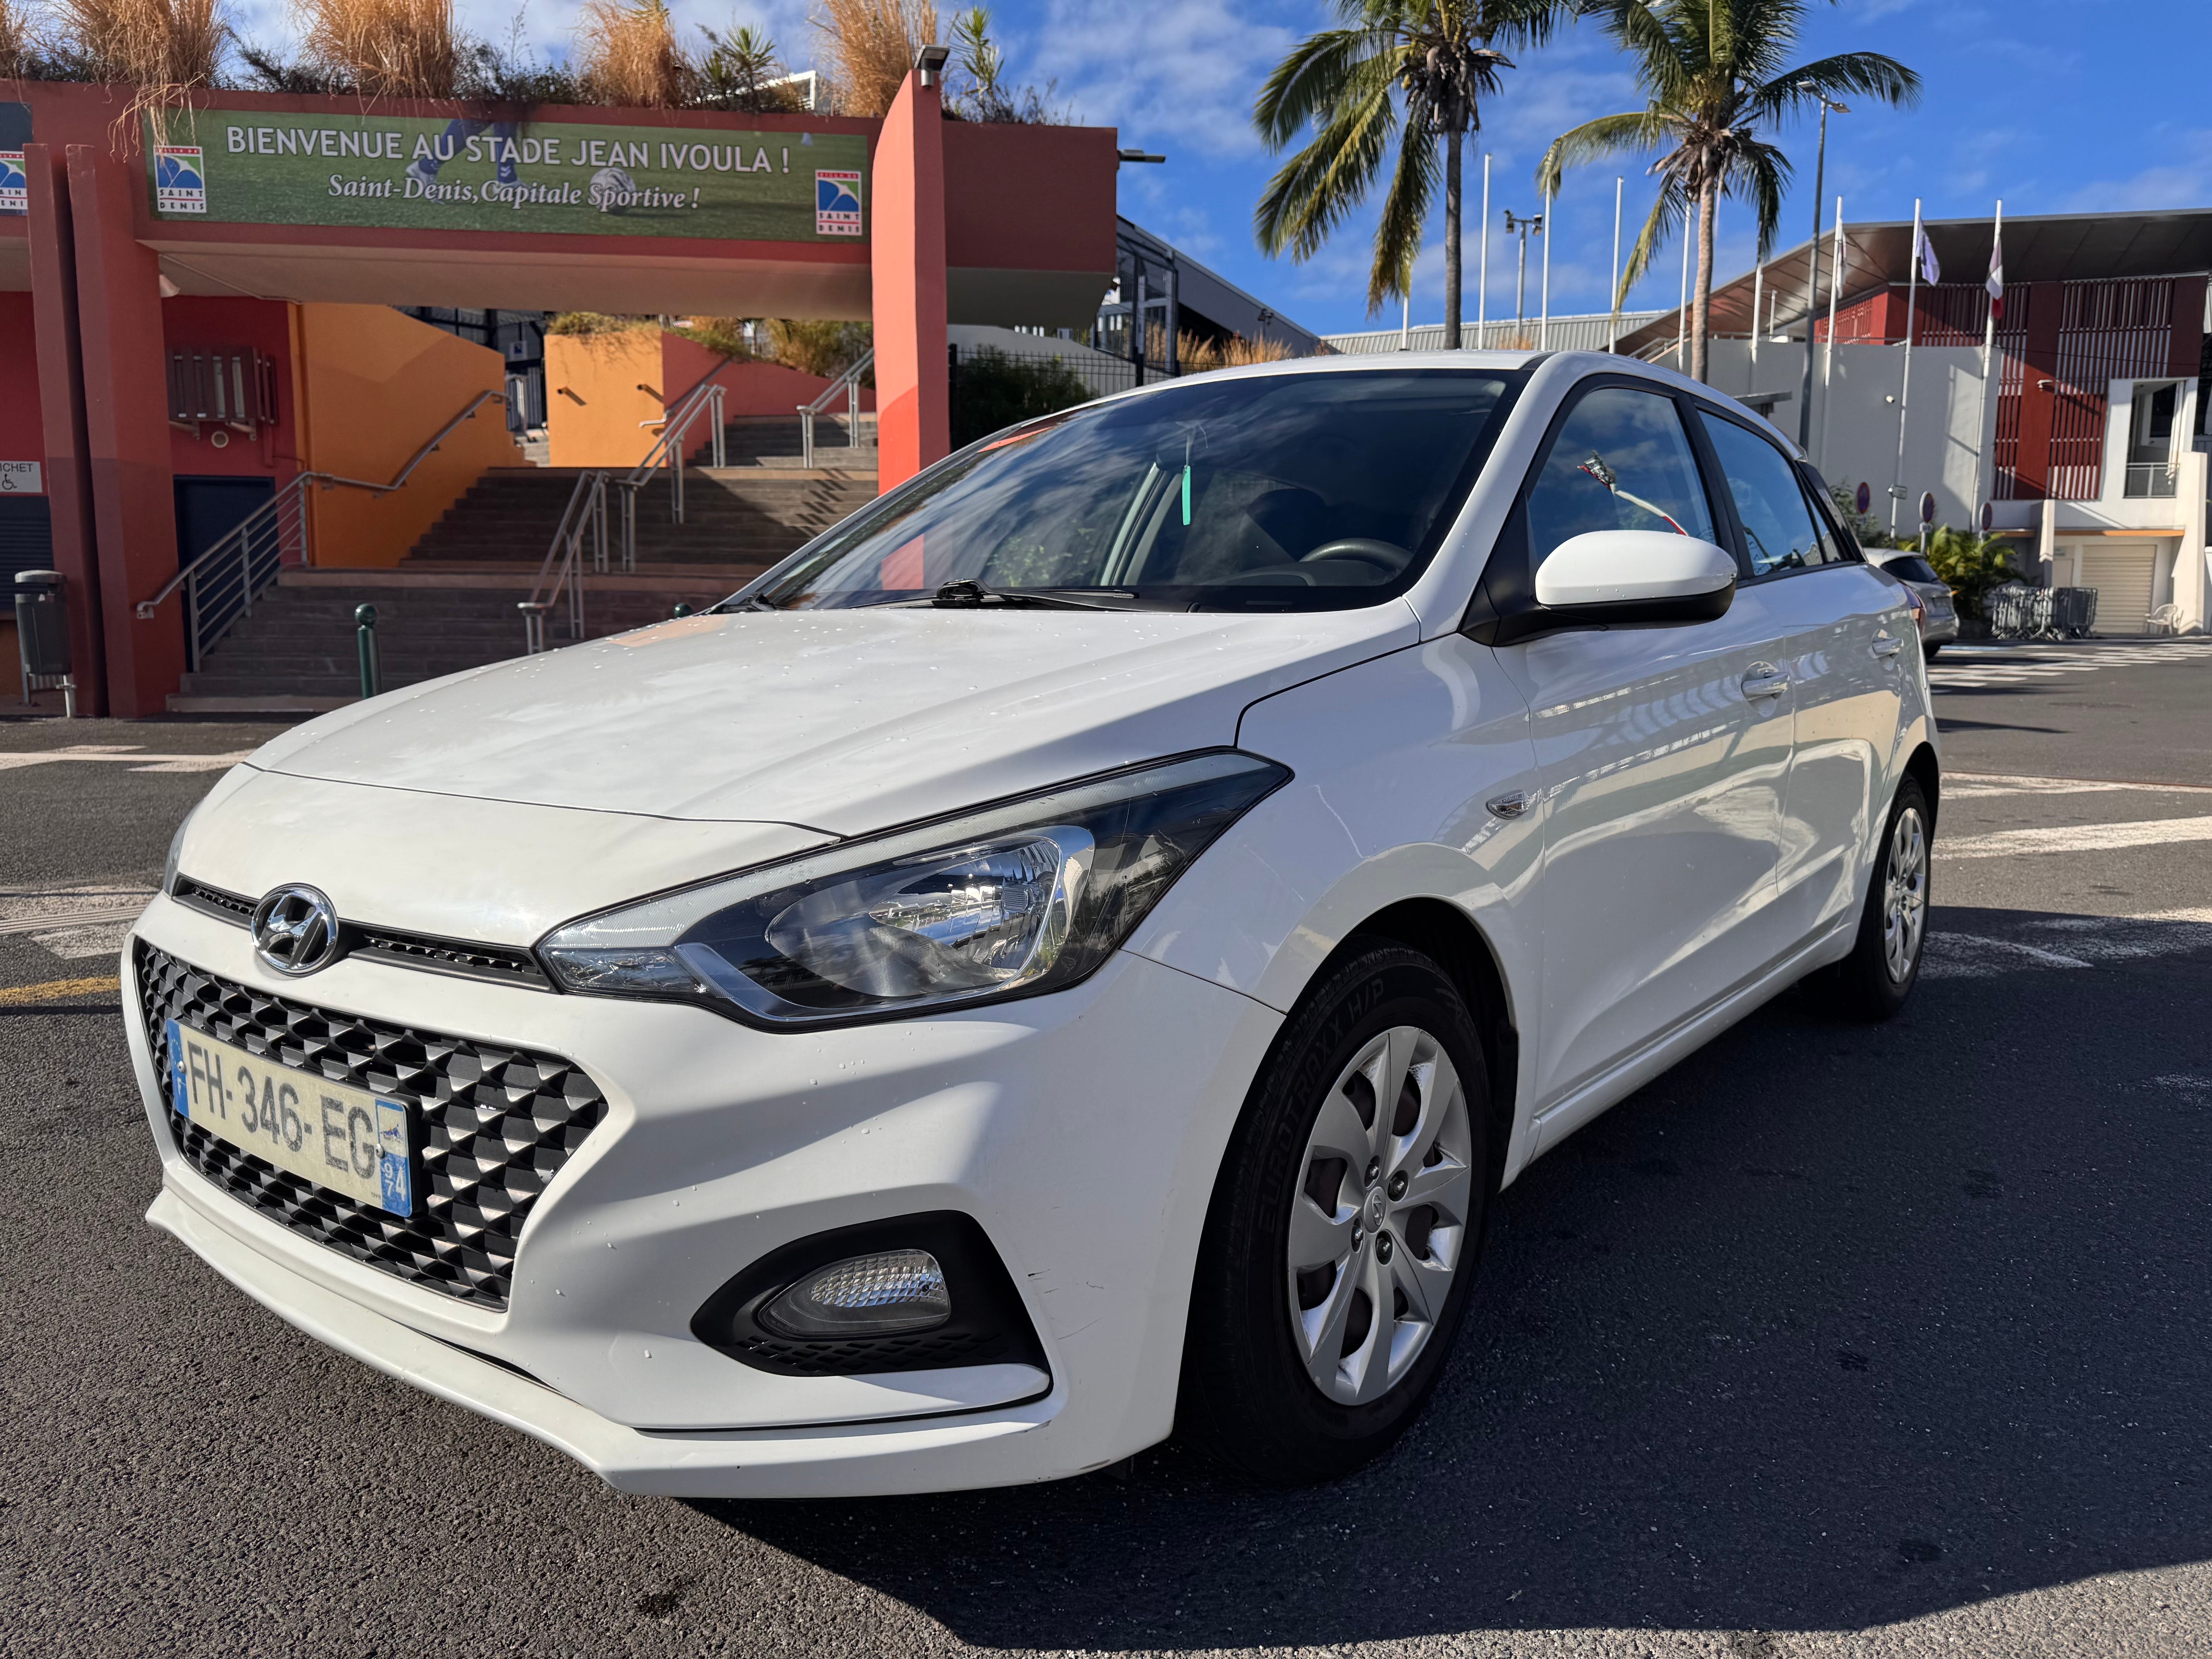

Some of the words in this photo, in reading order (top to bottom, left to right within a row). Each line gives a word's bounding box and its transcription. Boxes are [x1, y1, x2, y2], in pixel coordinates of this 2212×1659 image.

[227, 126, 403, 159] BIENVENUE
[411, 134, 454, 161] AU
[465, 136, 561, 165] STADE
[570, 140, 649, 168] JEAN
[660, 143, 772, 173] IVOULA
[480, 181, 581, 210] Capitale
[587, 184, 687, 212] Sportive
[187, 1041, 376, 1180] FH-346-EG
